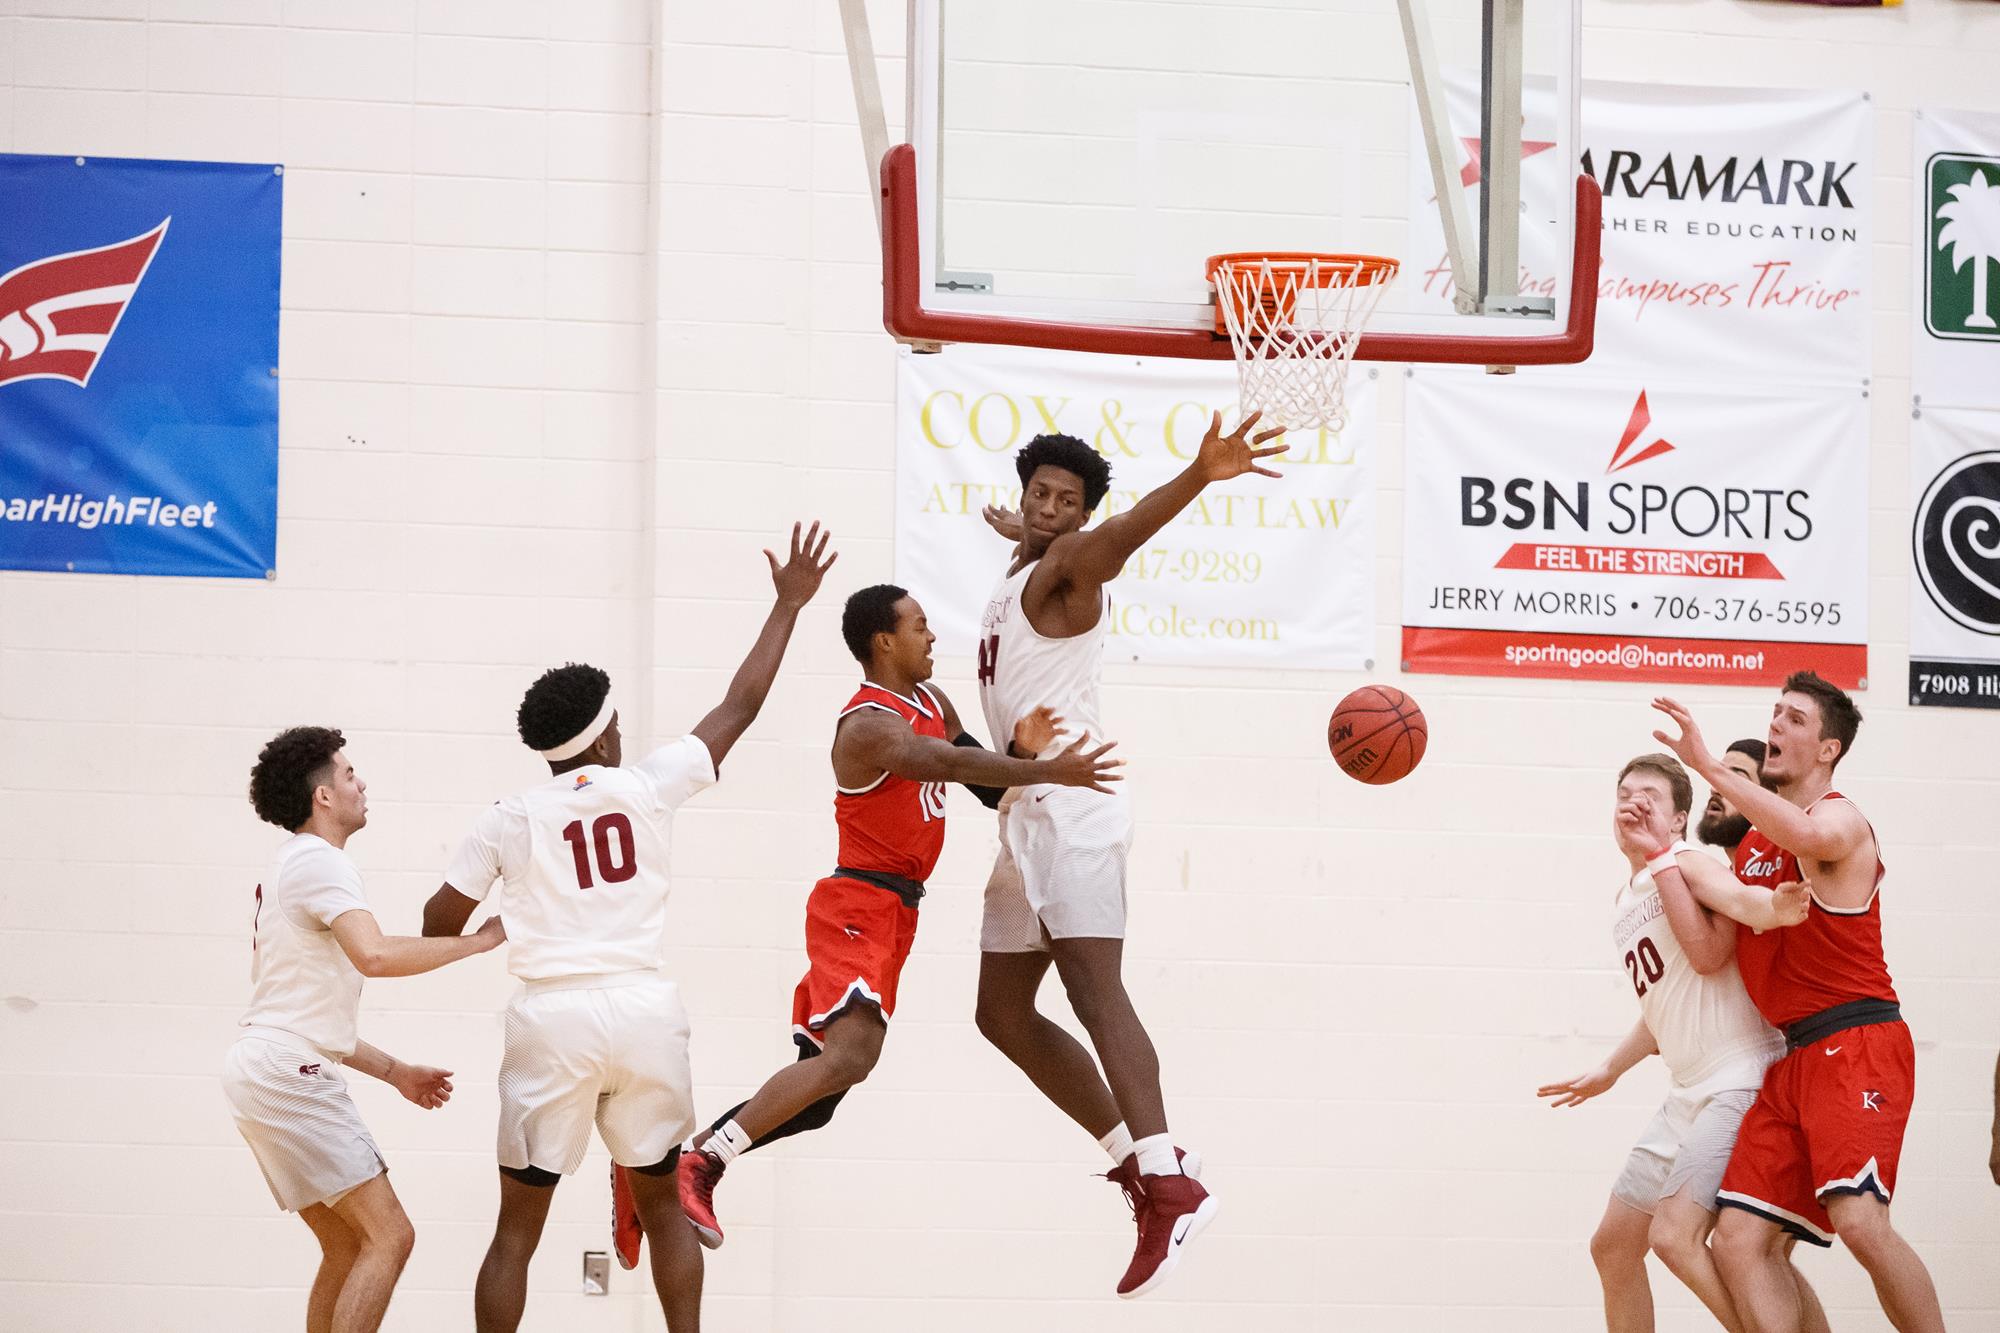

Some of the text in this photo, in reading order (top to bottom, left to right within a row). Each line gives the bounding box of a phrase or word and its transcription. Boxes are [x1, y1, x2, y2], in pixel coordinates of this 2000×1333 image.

[1687, 221, 1857, 242] EDUCATION
[1597, 257, 1740, 323] ampuses
[920, 389, 1073, 453] COX
[1093, 399, 1143, 459] &
[1186, 494, 1246, 528] AT
[1256, 496, 1352, 530] LAW
[1460, 476, 1813, 542] BSN SPORTS
[1534, 546, 1745, 577] FEEL THE STRENGTH
[1429, 586, 1842, 626] JERRY MORRIS 706-376-5595
[1504, 643, 1765, 670] sportngood@hartcom.net
[1919, 673, 2000, 700] 7908 Hi
[562, 811, 638, 890] 10
[1624, 936, 1665, 999] 20
[1861, 1090, 1880, 1113] K
